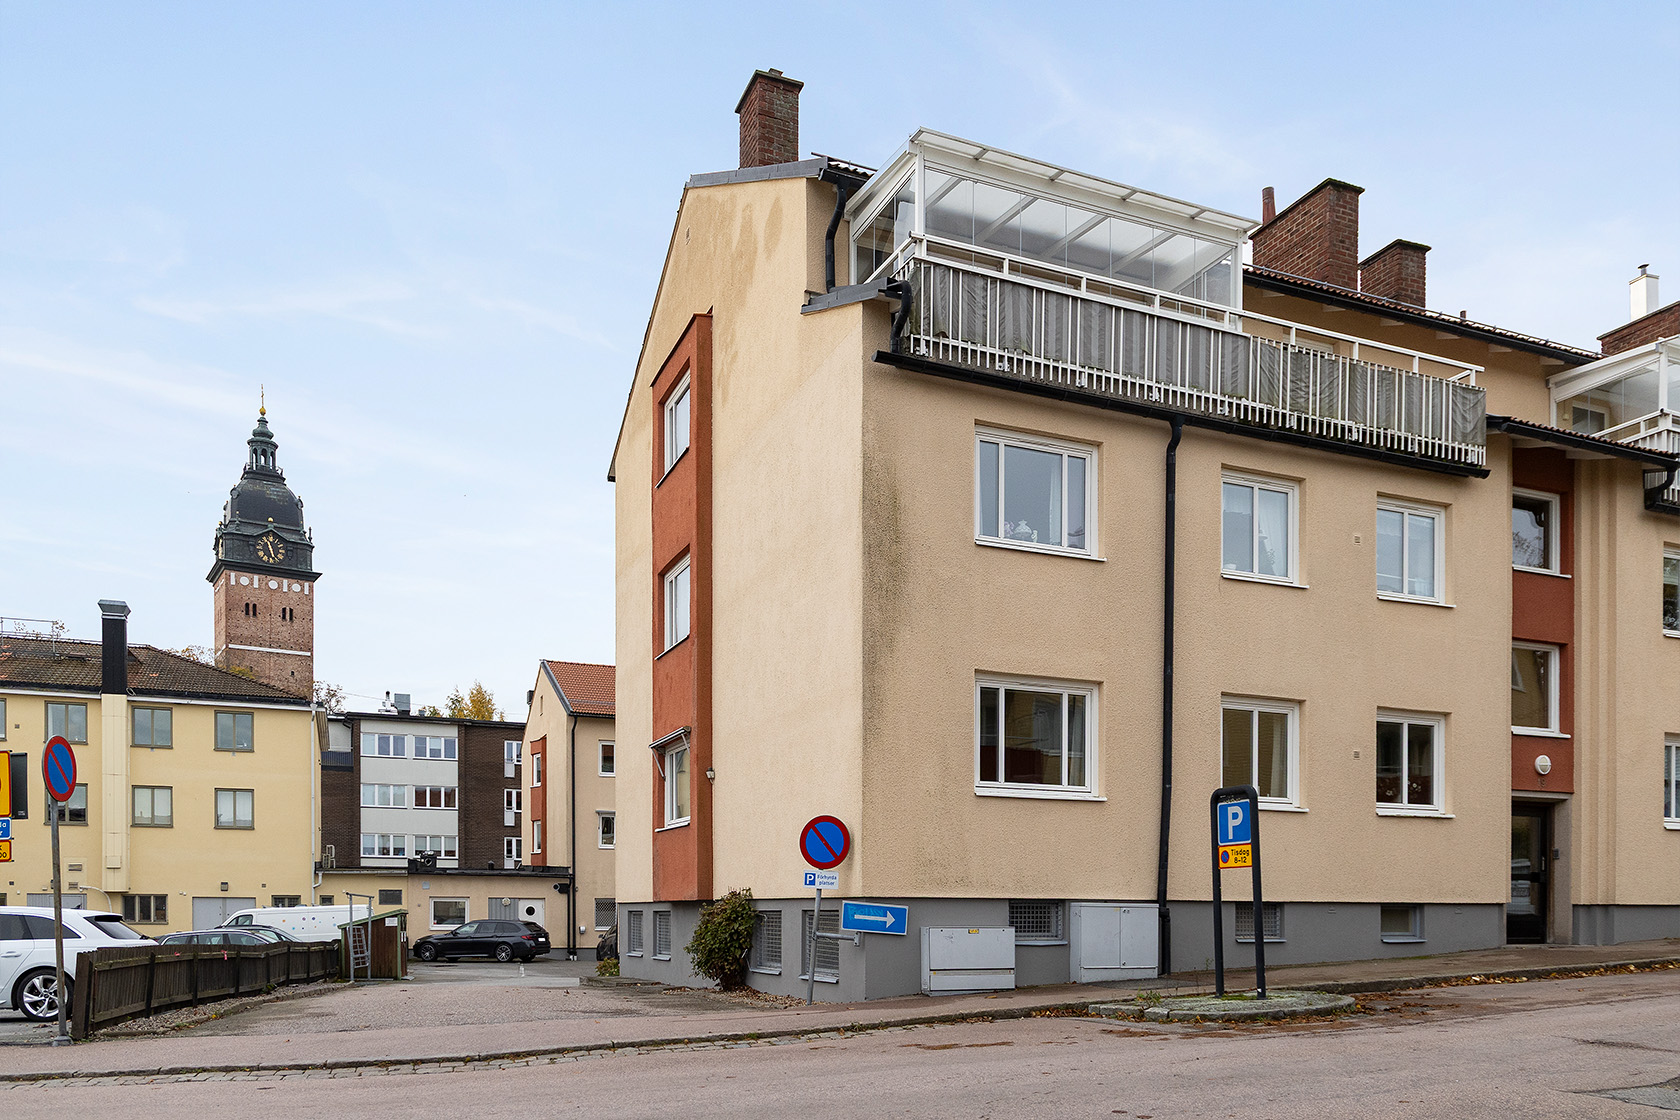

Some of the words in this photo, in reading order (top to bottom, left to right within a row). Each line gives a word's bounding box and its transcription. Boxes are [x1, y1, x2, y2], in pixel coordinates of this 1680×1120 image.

[1227, 806, 1243, 840] P
[1234, 856, 1247, 864] 8-12
[806, 874, 814, 884] P
